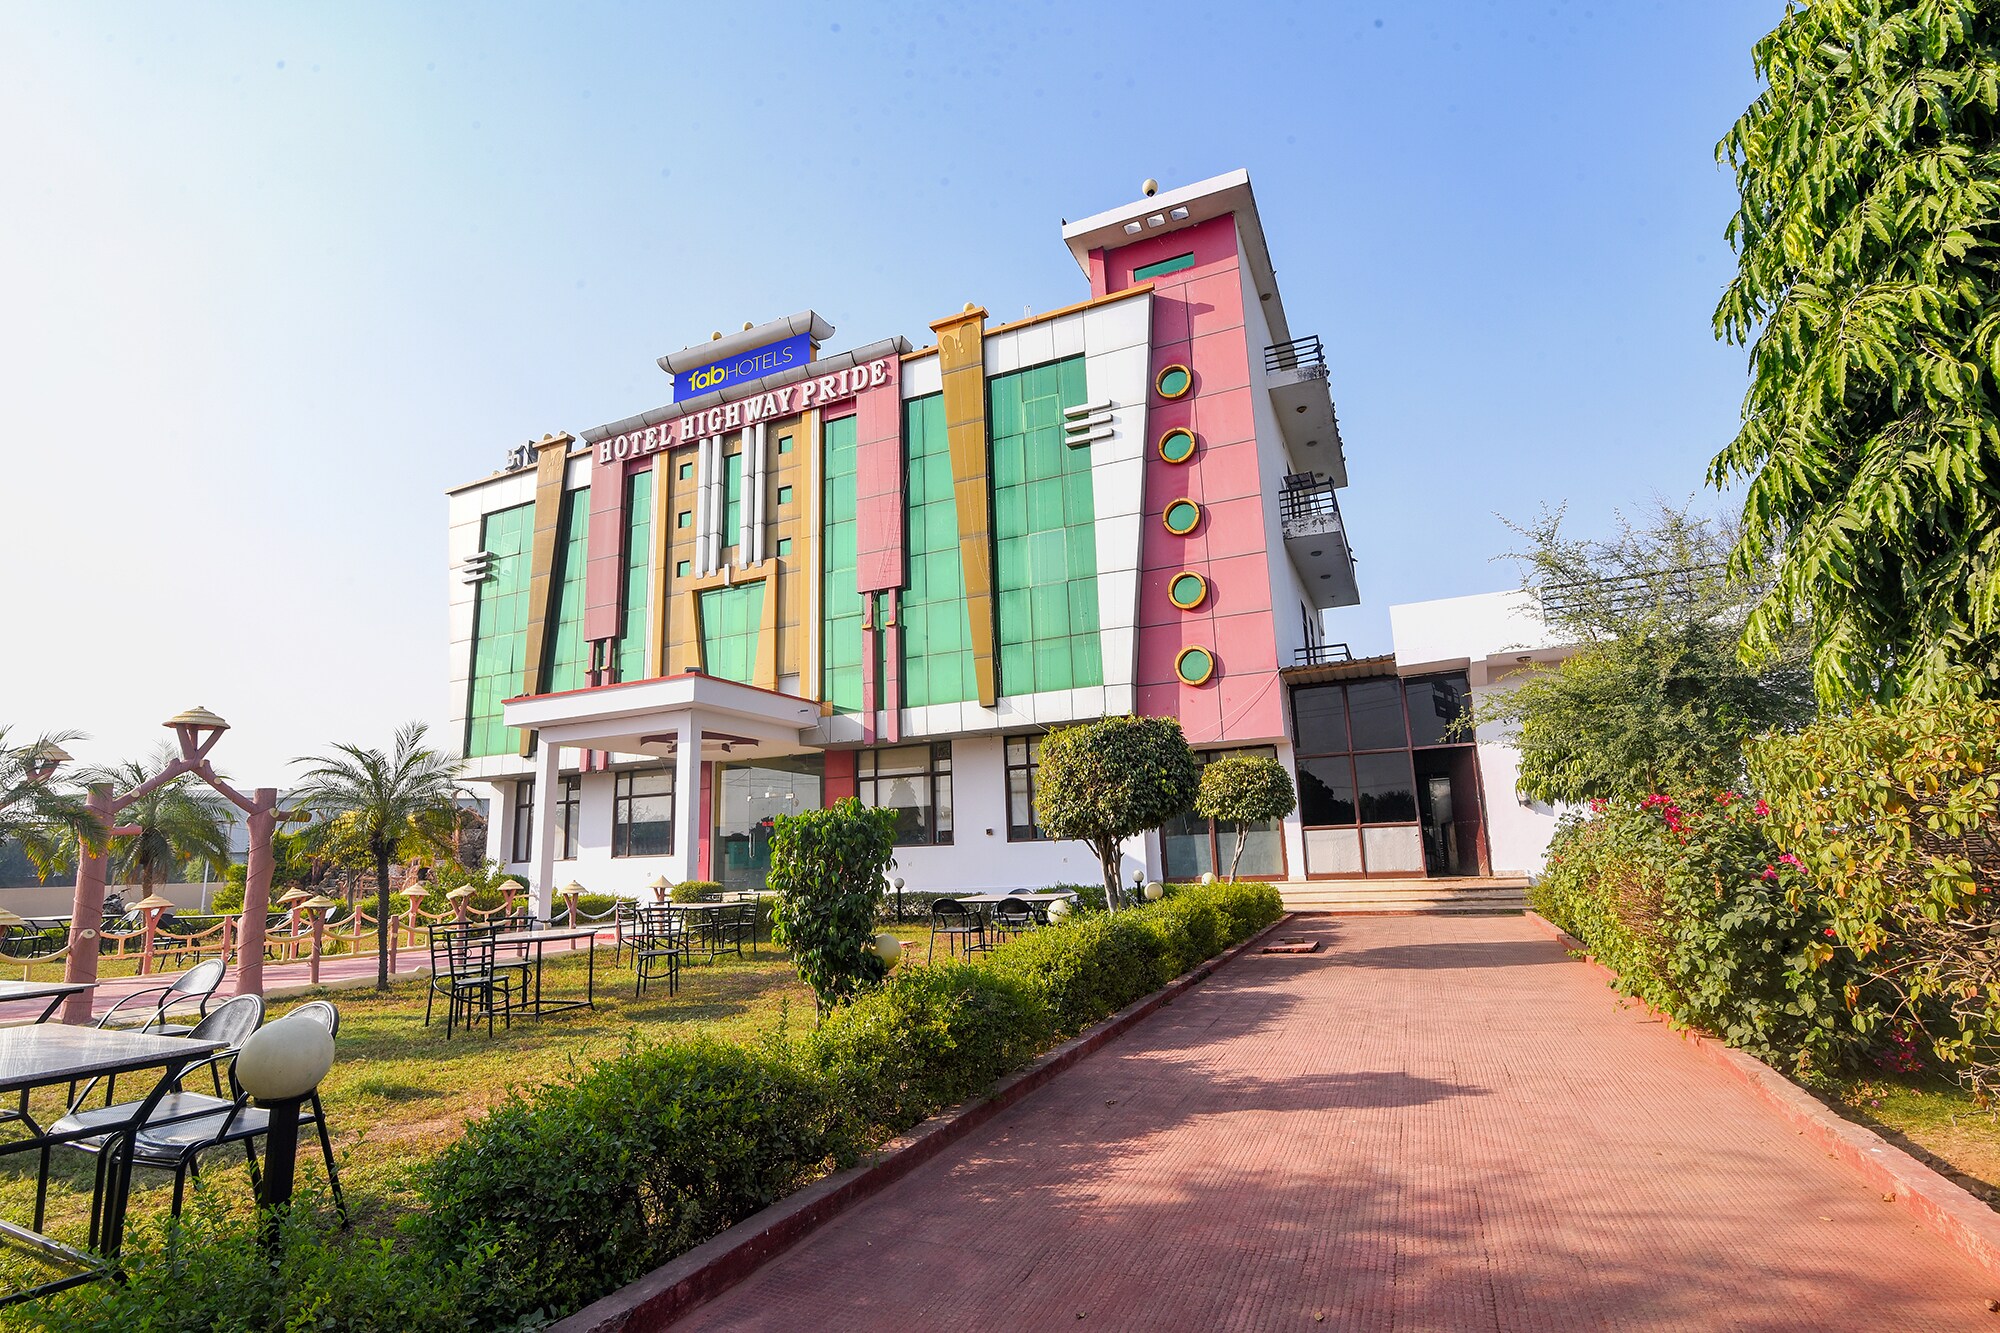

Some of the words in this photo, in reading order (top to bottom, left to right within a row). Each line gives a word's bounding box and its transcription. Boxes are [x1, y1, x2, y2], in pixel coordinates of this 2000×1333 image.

[599, 424, 673, 463] HOTEL
[680, 386, 793, 441] HIGHWAY
[798, 359, 888, 407] PRIDE
